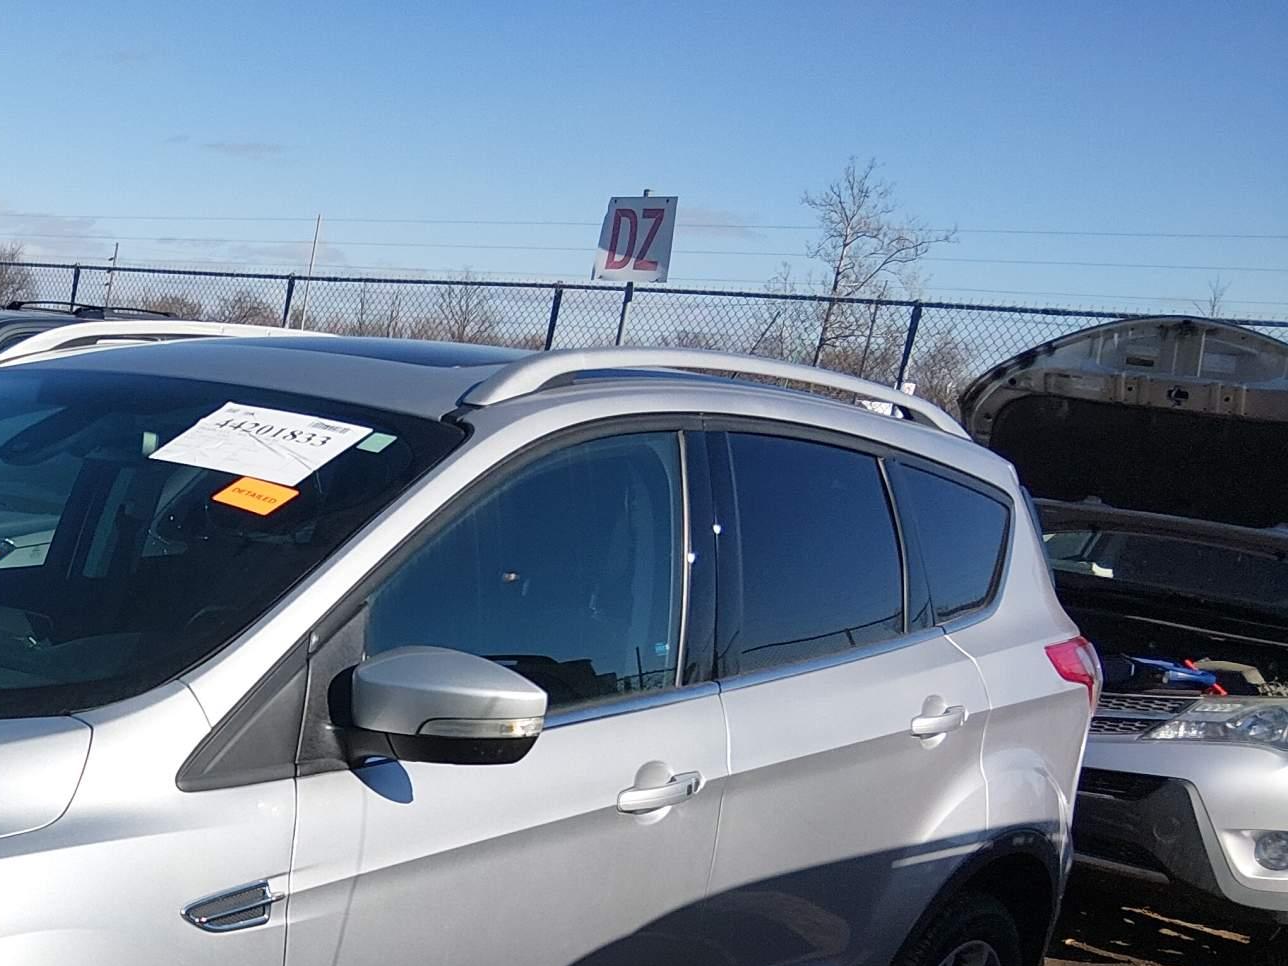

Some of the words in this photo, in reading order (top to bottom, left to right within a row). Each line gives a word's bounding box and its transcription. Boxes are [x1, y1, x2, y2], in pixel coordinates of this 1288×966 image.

[604, 208, 665, 271] DZ
[215, 417, 333, 448] 44201833
[230, 486, 279, 505] DETAILED
